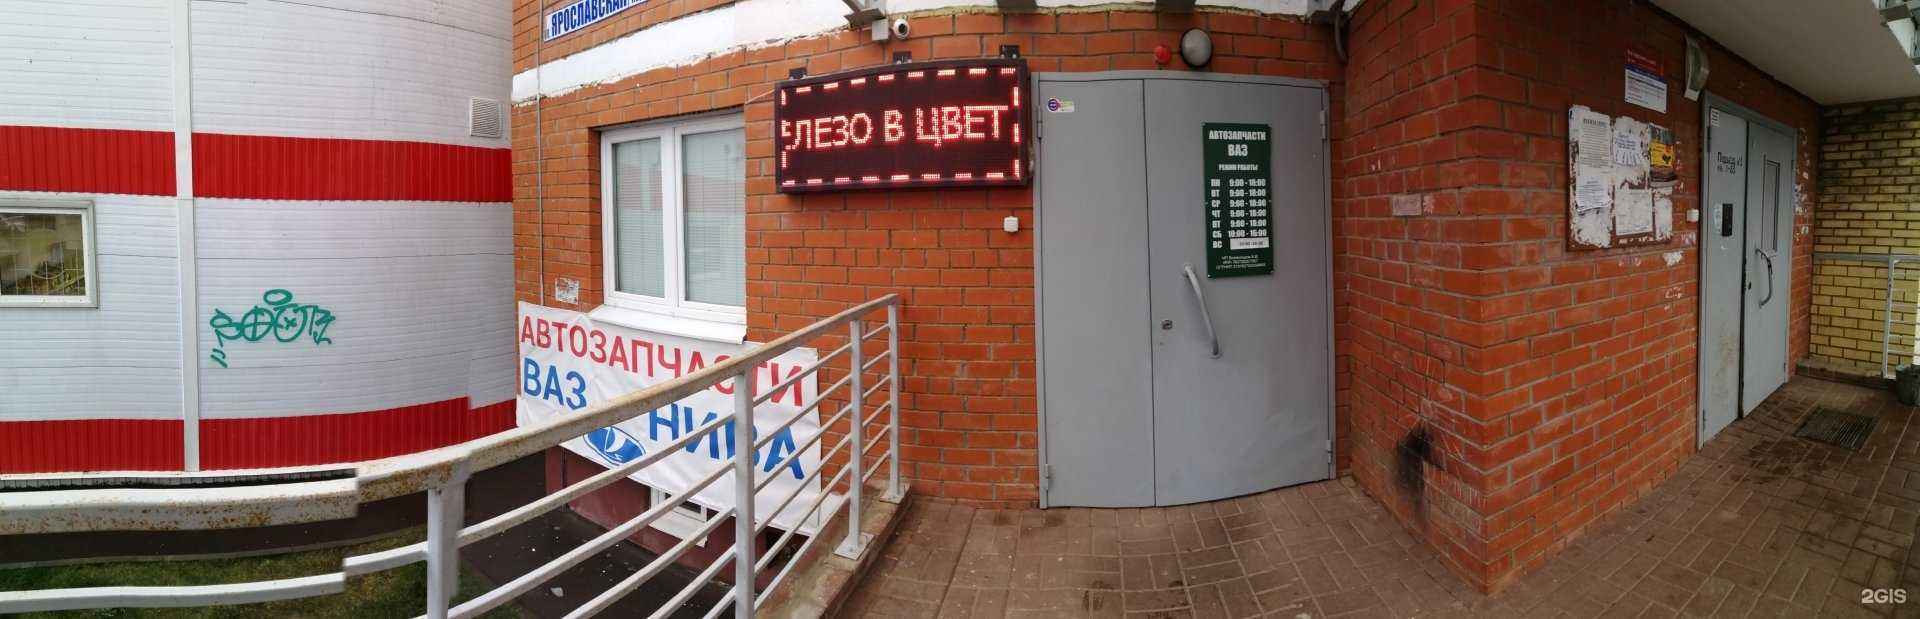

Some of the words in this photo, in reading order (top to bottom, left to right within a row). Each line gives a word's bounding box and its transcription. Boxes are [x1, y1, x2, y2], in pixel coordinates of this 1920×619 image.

[884, 110, 905, 142] В
[916, 105, 1009, 146] ЦВЕТ
[1208, 130, 1266, 141] АВТОЗАПЧАСТИ
[1227, 144, 1249, 157] ВАЗ
[1210, 178, 1221, 187] ПН
[1211, 189, 1220, 198] ВТ
[1211, 199, 1221, 208] СР
[1211, 209, 1221, 218] ЧТ
[1212, 220, 1221, 229] ПТ
[1212, 230, 1223, 238] СБ
[1213, 240, 1223, 249] ВС
[523, 356, 588, 412] ВАЗ
